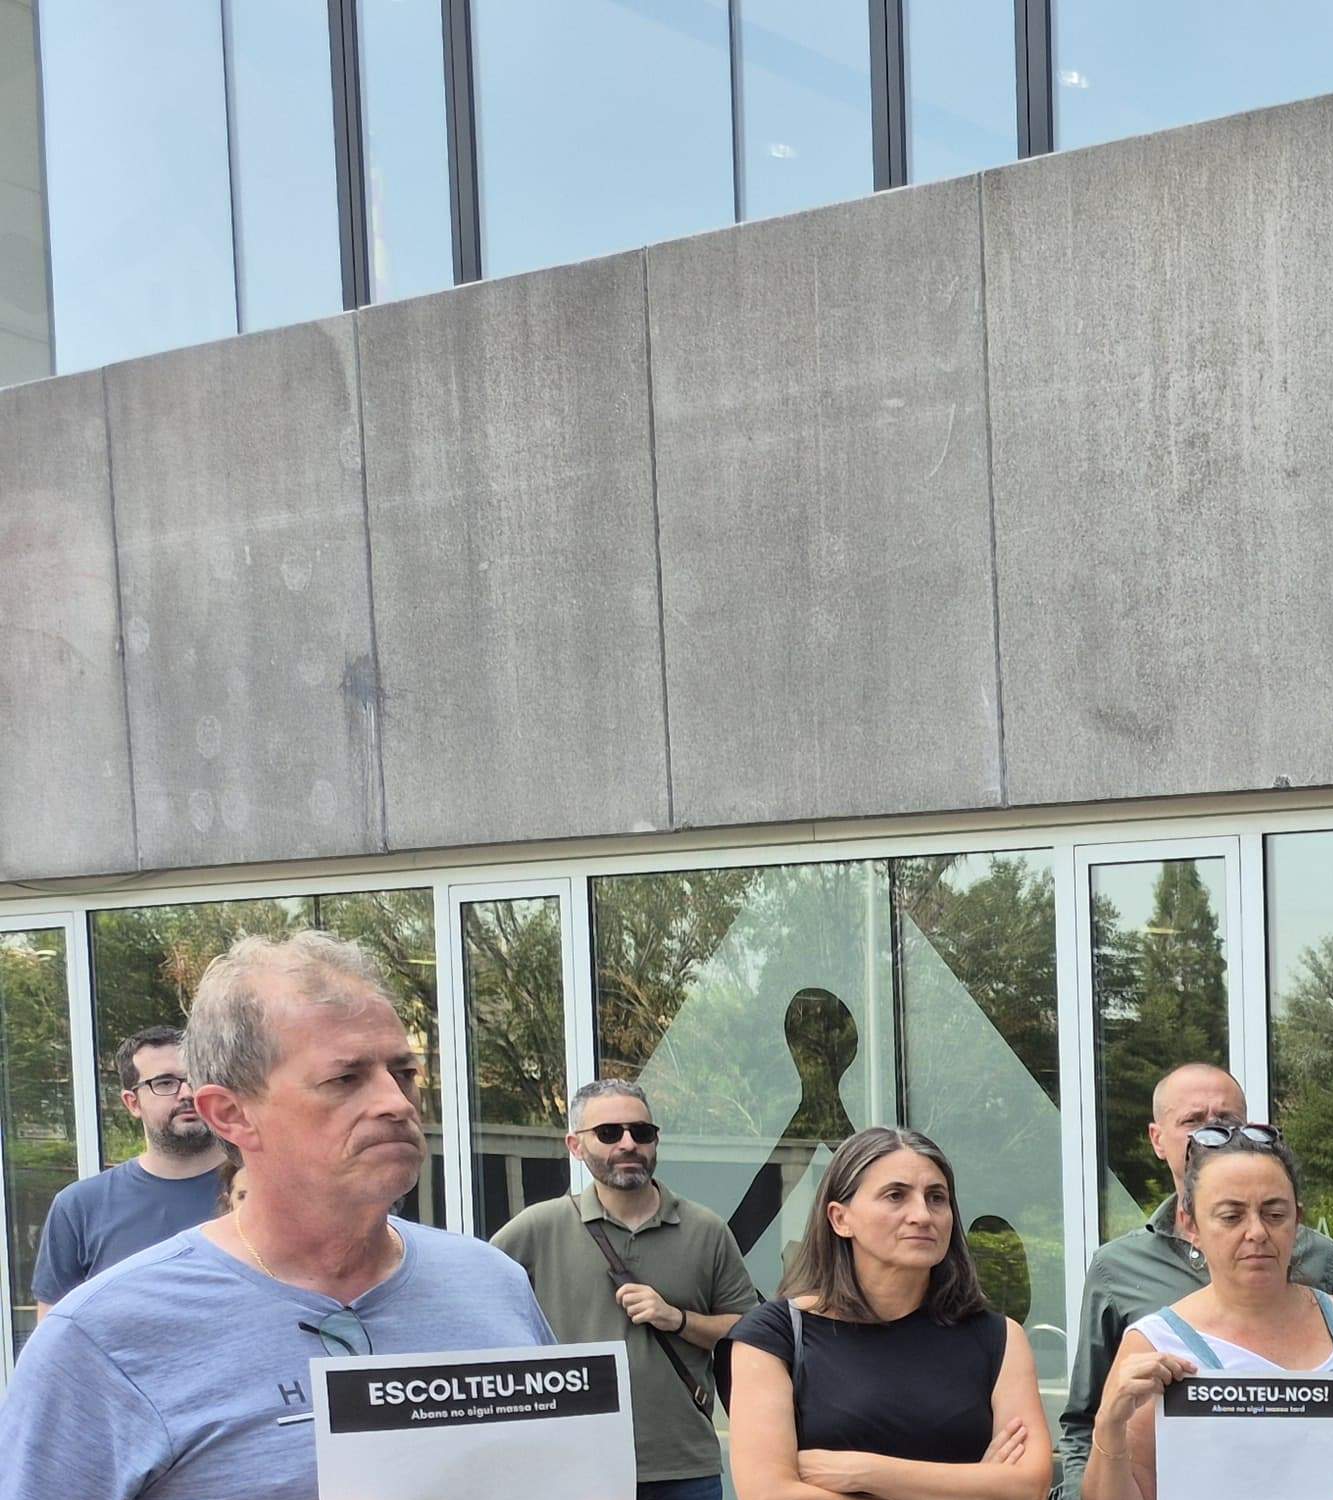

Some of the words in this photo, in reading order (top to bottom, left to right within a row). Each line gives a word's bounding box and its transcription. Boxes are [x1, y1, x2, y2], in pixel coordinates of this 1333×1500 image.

[368, 1367, 590, 1406] ESCOLTEU-NOS!
[1187, 1385, 1329, 1402] ESCOLTEU-NOS!
[411, 1408, 448, 1420] Abans
[451, 1409, 465, 1418] no
[467, 1405, 494, 1418] sigui
[496, 1404, 532, 1414] massa
[534, 1399, 557, 1411] tard
